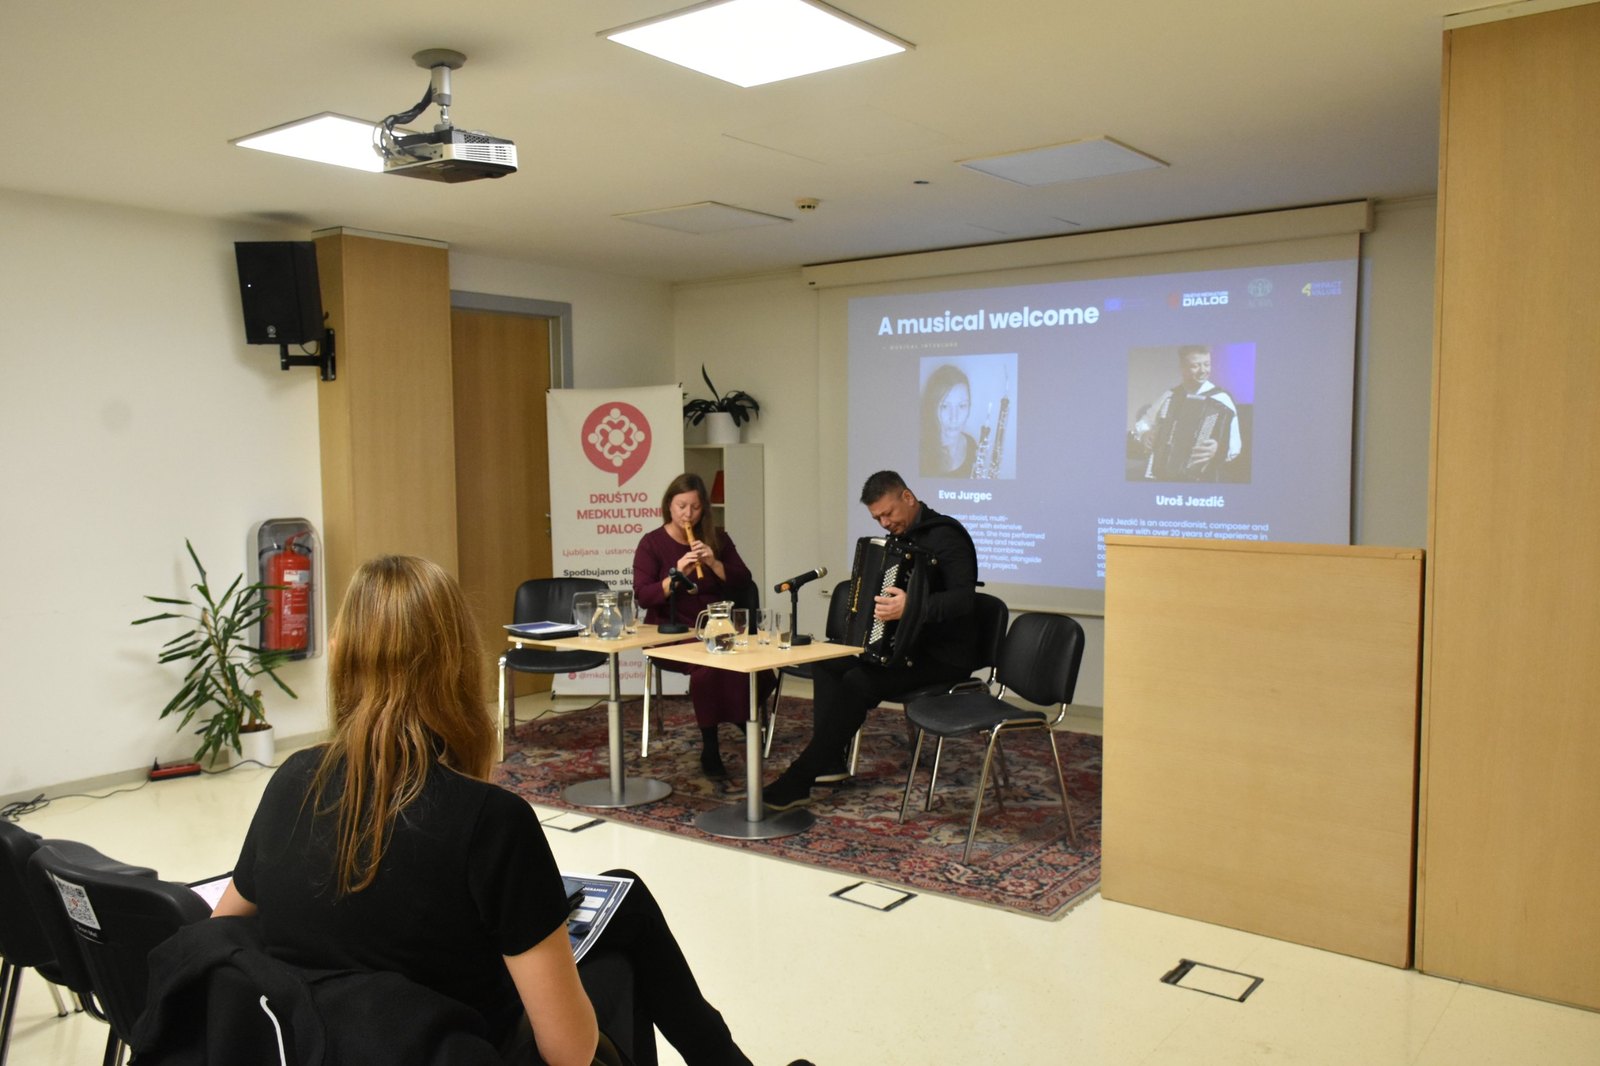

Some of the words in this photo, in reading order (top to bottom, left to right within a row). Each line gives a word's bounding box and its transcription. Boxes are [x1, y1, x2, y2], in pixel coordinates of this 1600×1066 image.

[1182, 295, 1229, 306] DIALOG
[878, 316, 894, 335] A
[897, 309, 985, 334] musical
[989, 306, 1100, 329] welcome
[589, 491, 648, 504] DRUŠTVO
[938, 490, 957, 500] Eva
[957, 490, 992, 503] Jurgec
[1156, 495, 1183, 506] Uroš
[1185, 496, 1225, 507] Jezdić
[597, 523, 643, 535] DIALOG
[1139, 518, 1146, 526] is
[1209, 523, 1250, 532] composer
[1251, 523, 1269, 532] and
[1011, 532, 1046, 540] performed
[1098, 527, 1134, 535] performer
[1135, 527, 1151, 535] with
[1152, 529, 1170, 537] over
[1170, 529, 1181, 537] 20
[1181, 530, 1203, 538] years
[1204, 530, 1213, 538] of
[1214, 531, 1259, 541] experience
[1259, 533, 1268, 541] in
[562, 548, 599, 557] Ljubljana
[563, 568, 620, 577] Spodbujamo
